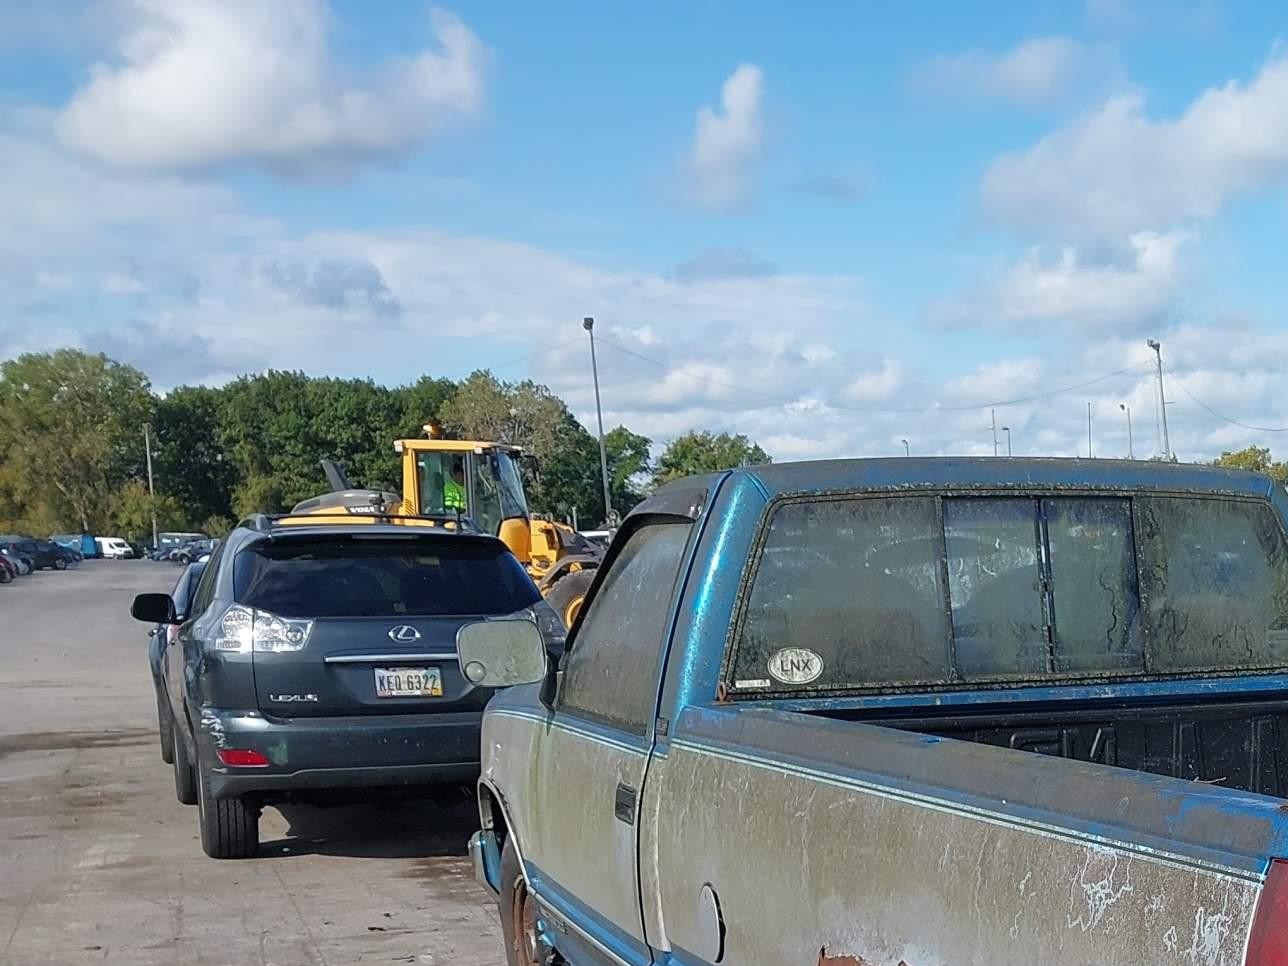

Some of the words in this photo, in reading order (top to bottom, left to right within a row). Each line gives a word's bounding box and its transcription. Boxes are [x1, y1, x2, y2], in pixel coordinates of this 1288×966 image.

[780, 658, 812, 672] LNX
[406, 672, 438, 691] 6322
[269, 694, 319, 702] LEXUS
